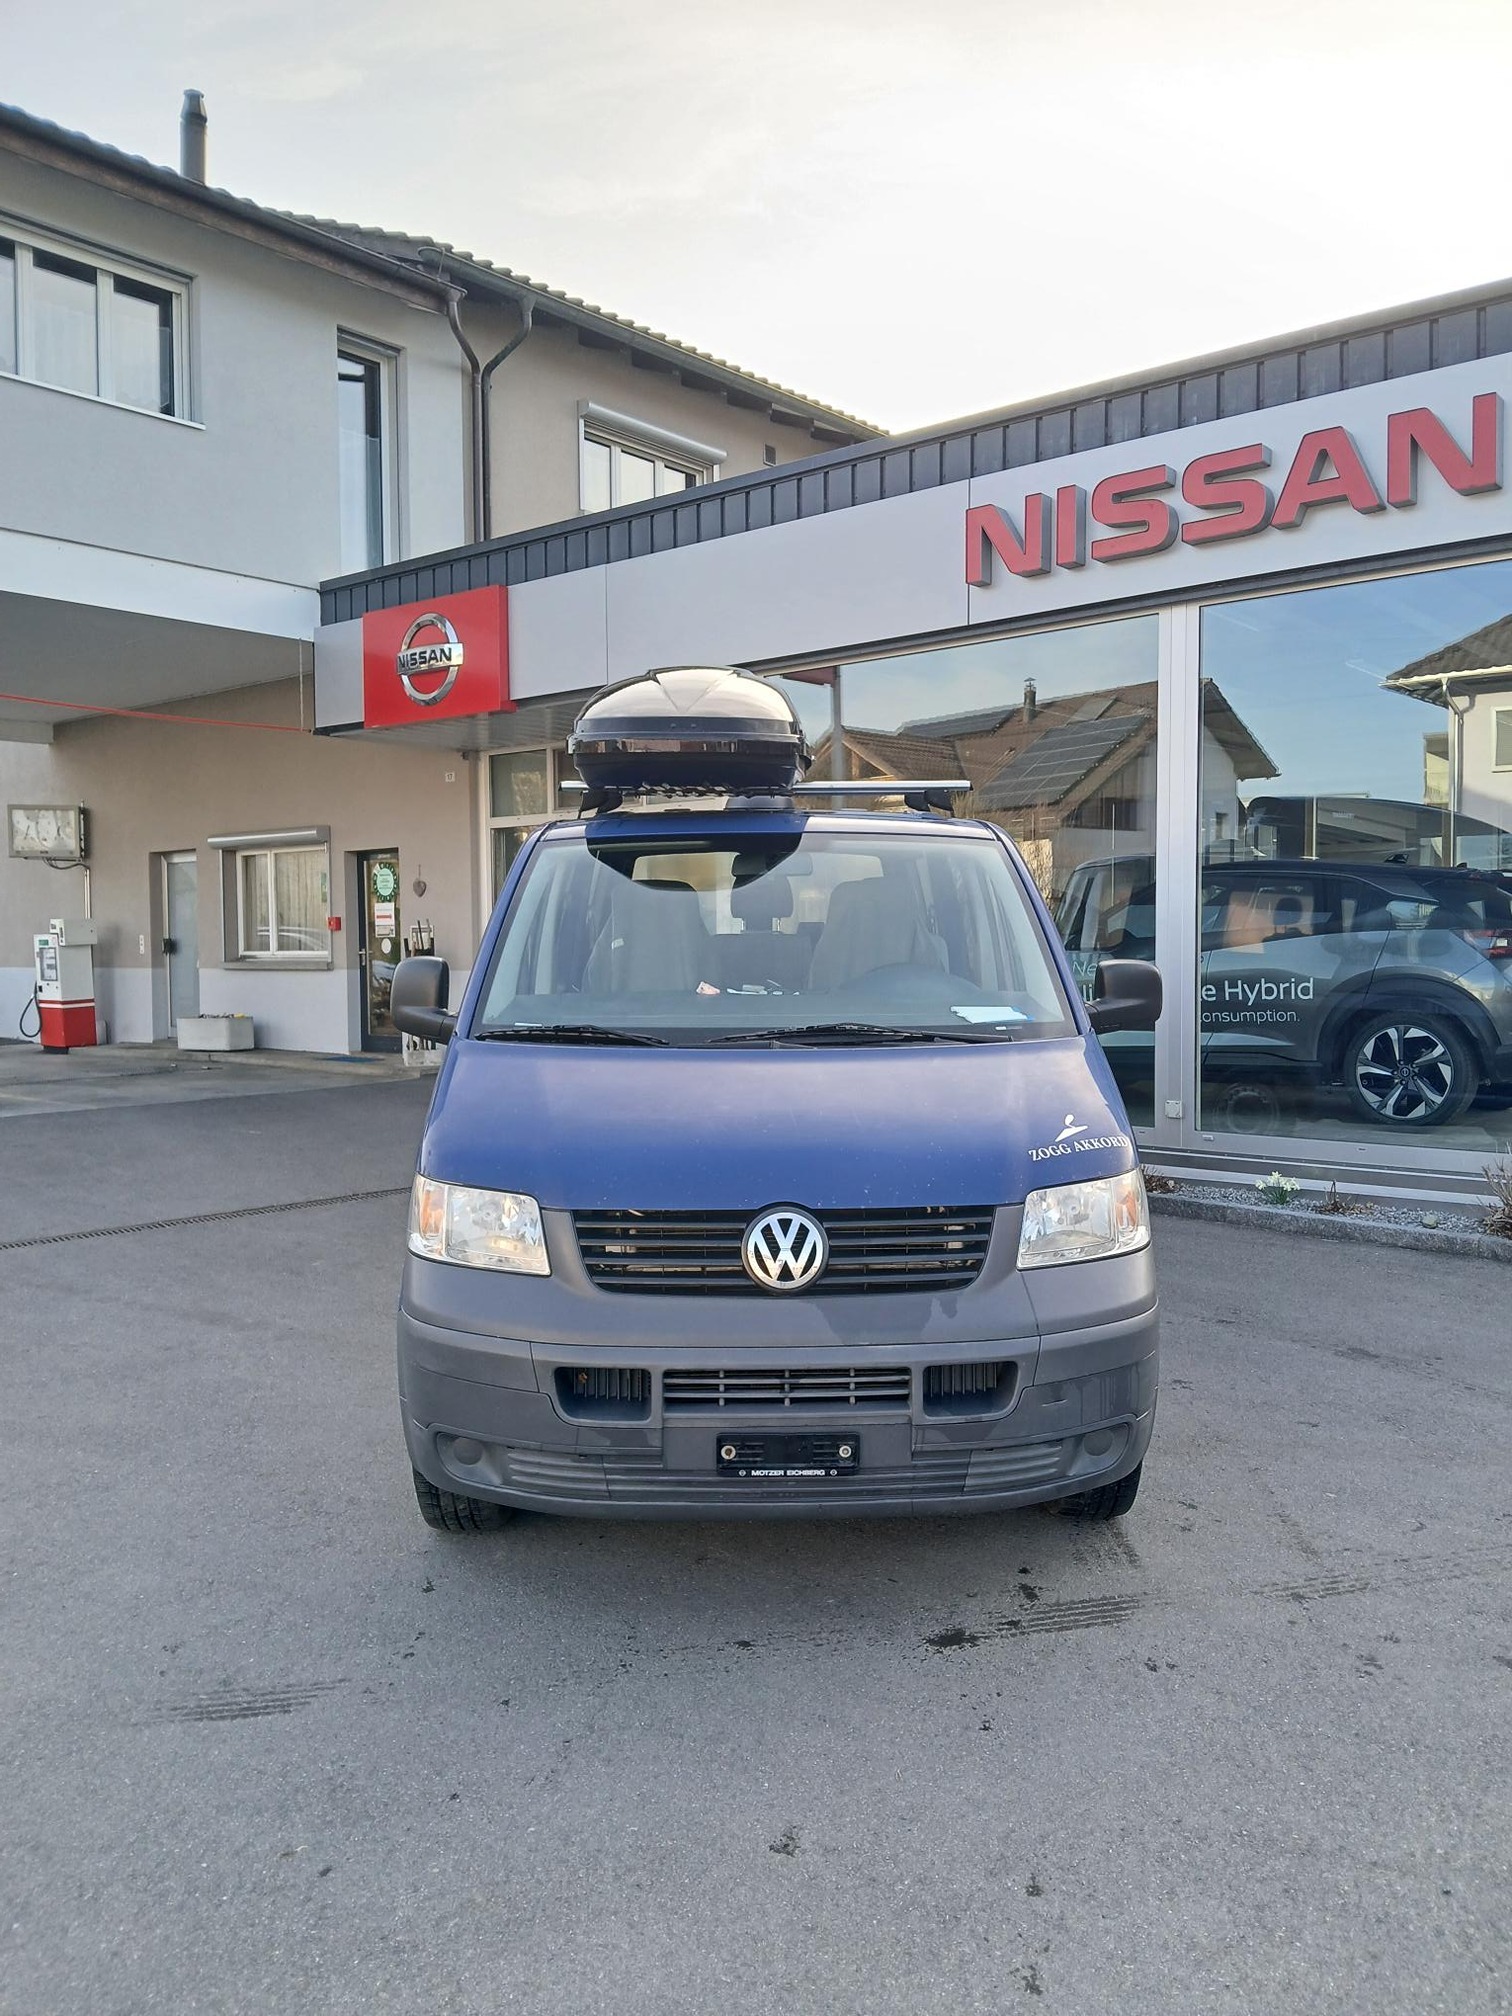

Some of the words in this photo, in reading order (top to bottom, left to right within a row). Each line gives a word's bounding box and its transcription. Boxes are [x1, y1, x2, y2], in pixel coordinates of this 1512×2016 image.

[966, 392, 1502, 587] NISSAN
[398, 648, 452, 668] NISSAN
[1225, 977, 1314, 1006] Hybrid
[1200, 1008, 1300, 1025] onsumption.
[1029, 1143, 1071, 1161] ZOGG
[1074, 1136, 1128, 1152] AKKORD
